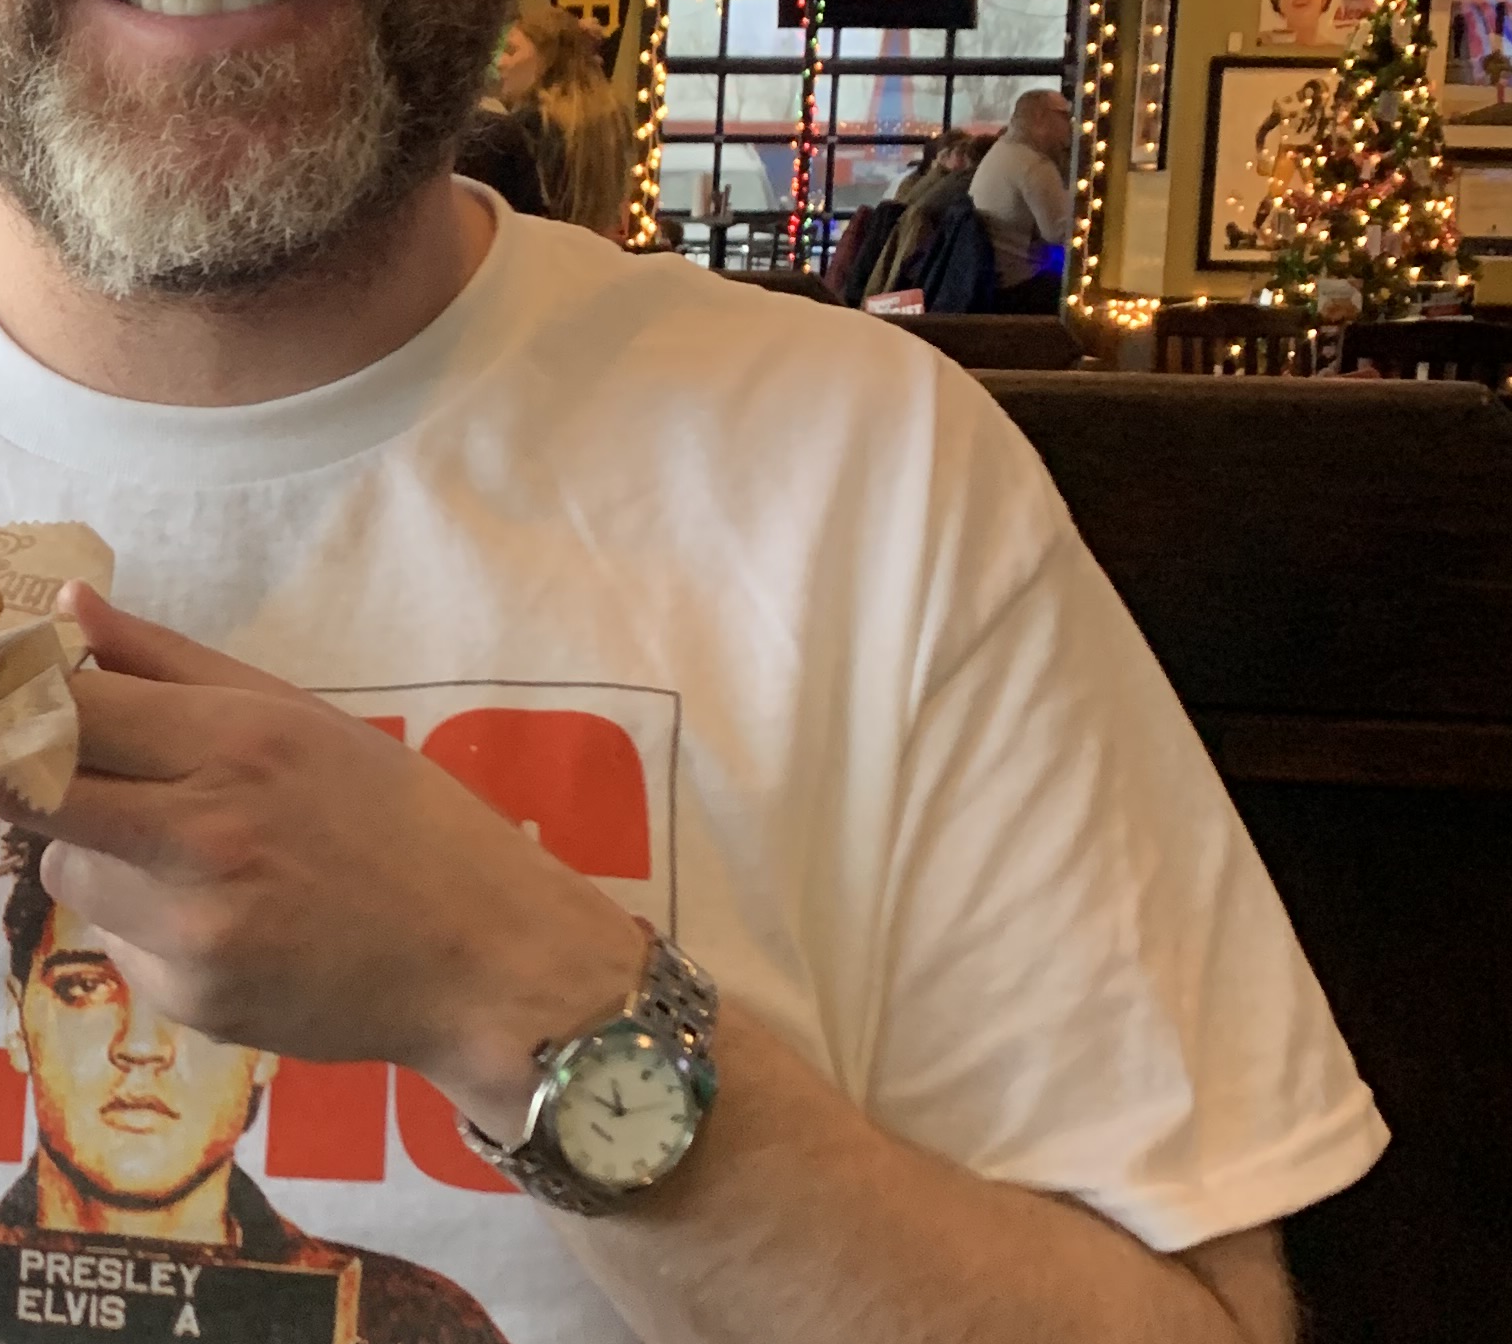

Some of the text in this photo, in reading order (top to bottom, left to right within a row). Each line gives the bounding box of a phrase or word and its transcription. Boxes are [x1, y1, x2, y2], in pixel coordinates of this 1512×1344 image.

[20, 1248, 201, 1297] PRESLEY
[17, 1288, 200, 1337] ELVIS A
